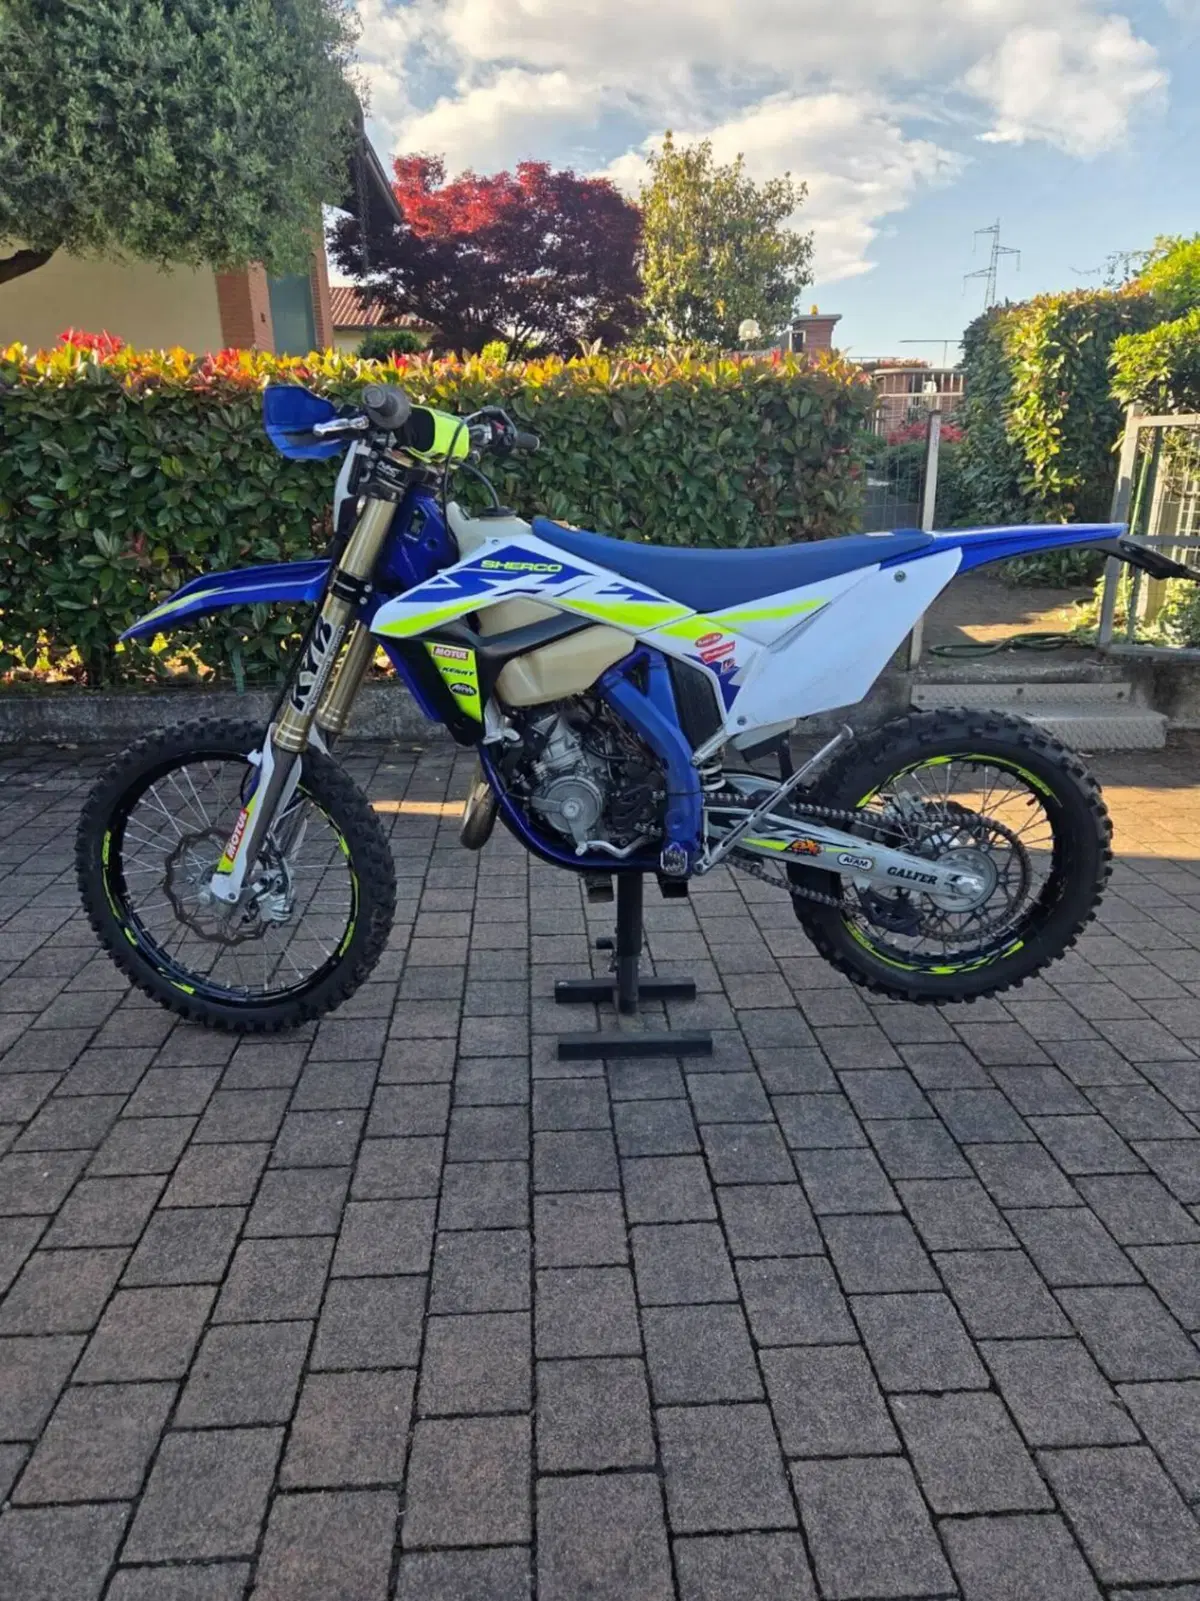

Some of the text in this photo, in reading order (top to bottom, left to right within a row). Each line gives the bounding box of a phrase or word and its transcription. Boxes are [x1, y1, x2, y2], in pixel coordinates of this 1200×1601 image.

[481, 560, 563, 572] SHERCO
[435, 646, 467, 660] MOTUL
[225, 810, 248, 859] MOTUL
[886, 866, 938, 885] GALFER
